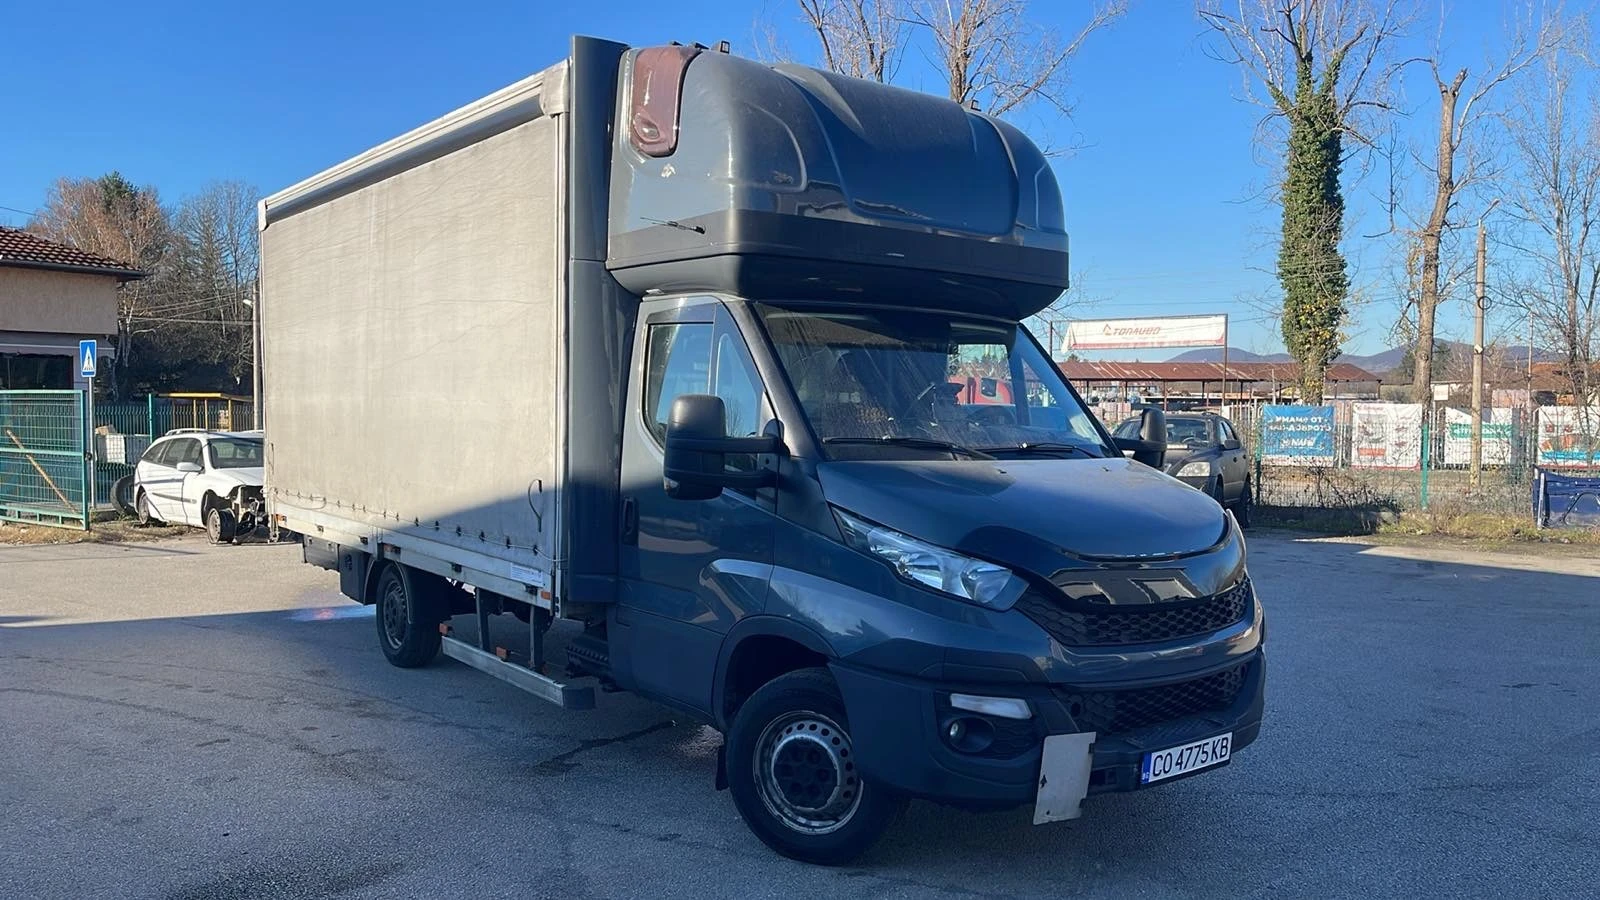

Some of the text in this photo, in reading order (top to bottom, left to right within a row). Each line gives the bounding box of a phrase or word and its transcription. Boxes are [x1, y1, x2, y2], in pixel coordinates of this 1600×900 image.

[1153, 736, 1229, 776] CO 4775 KB
